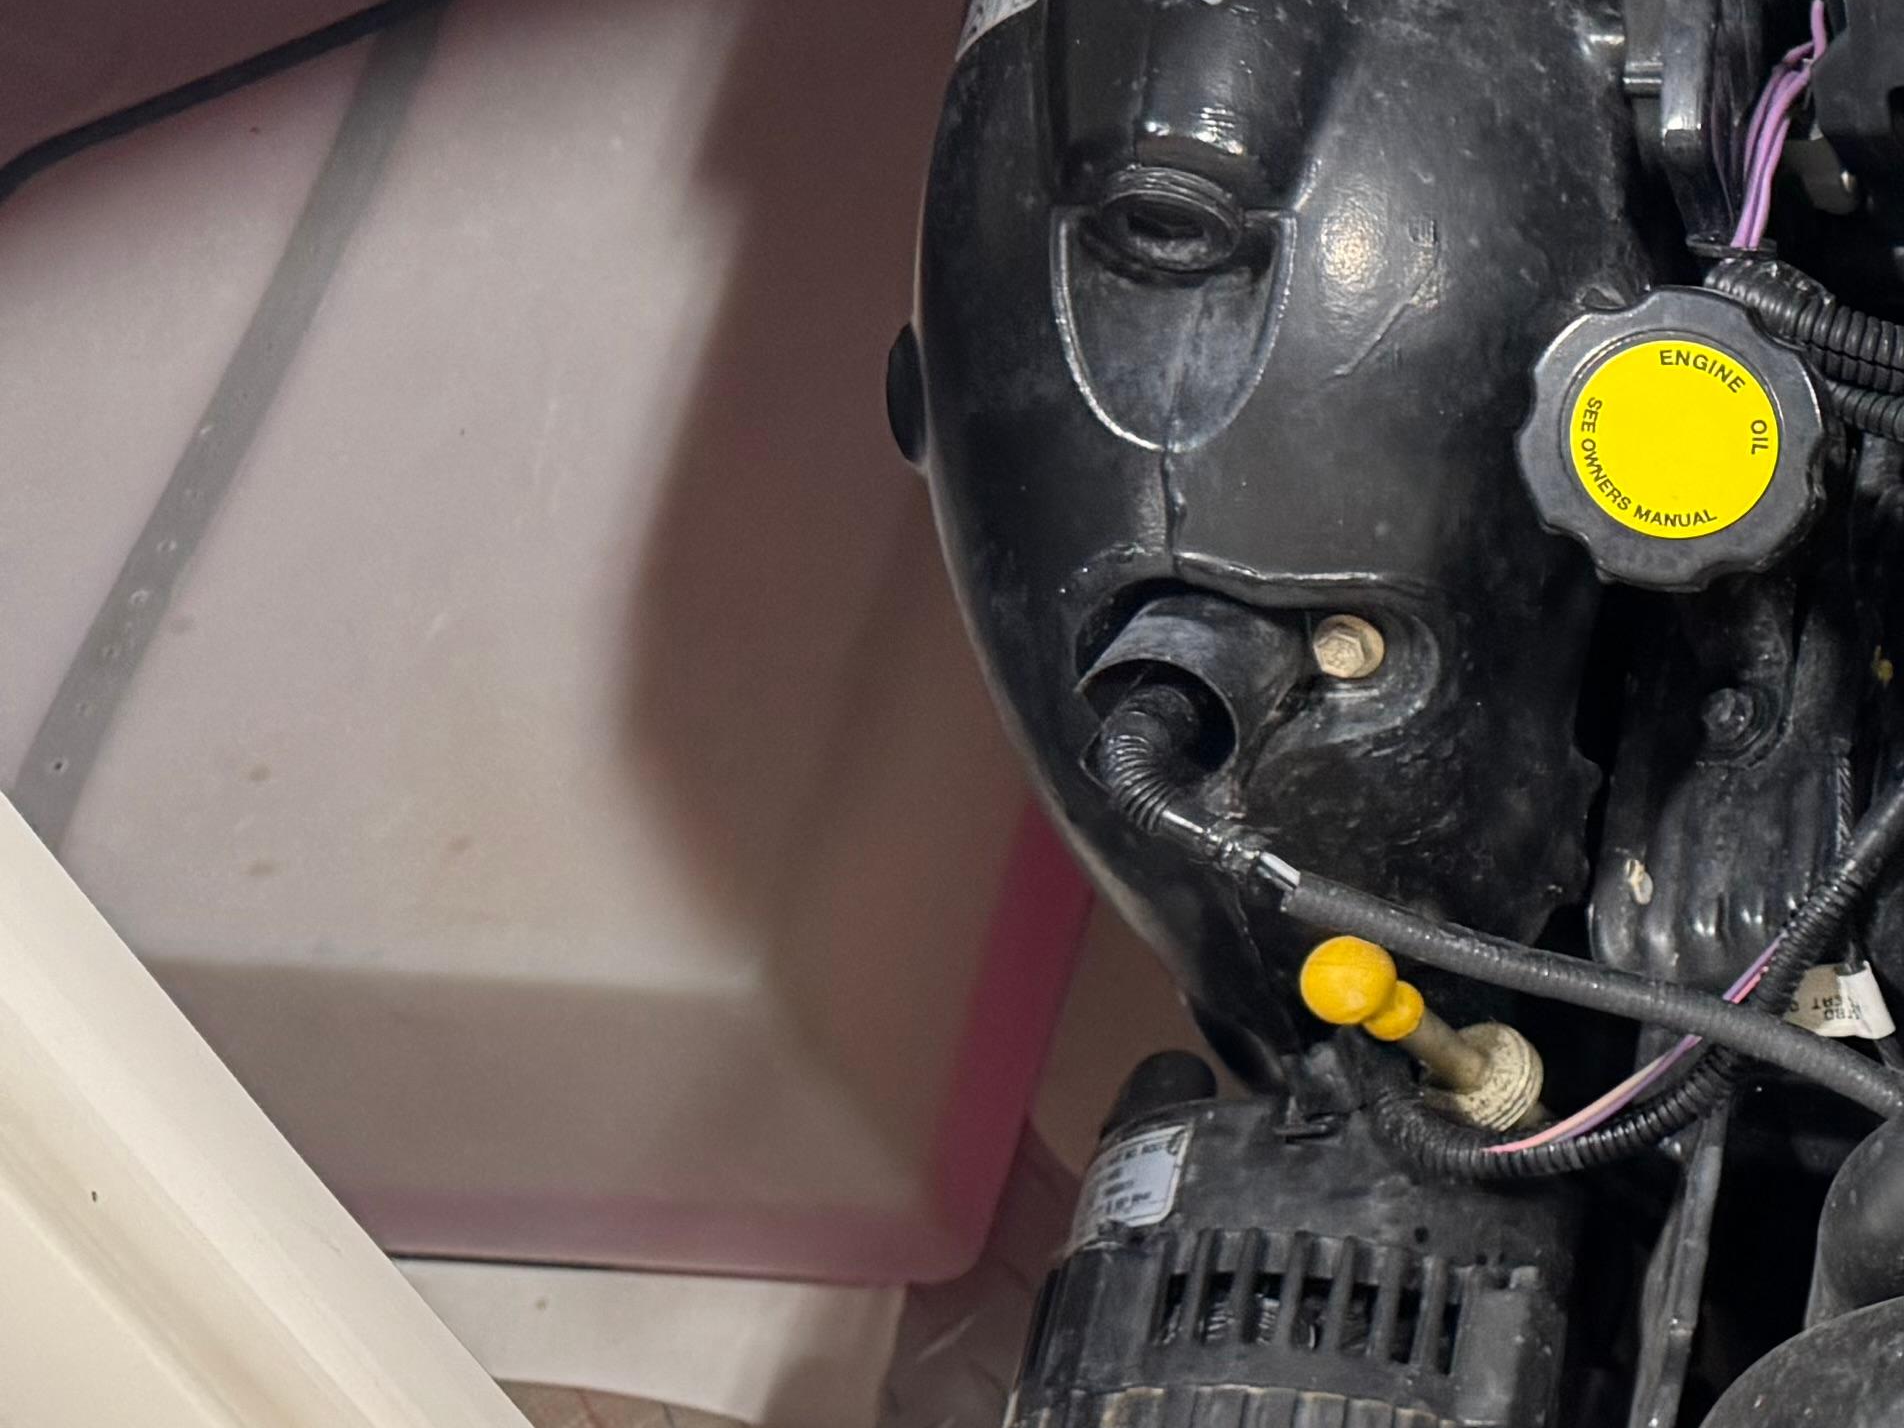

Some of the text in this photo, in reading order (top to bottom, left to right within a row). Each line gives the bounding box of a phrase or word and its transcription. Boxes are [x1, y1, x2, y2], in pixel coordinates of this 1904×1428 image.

[1659, 349, 1769, 455] ENGINE OIL
[1581, 397, 1718, 527] SEE OWNERS MANUAL
